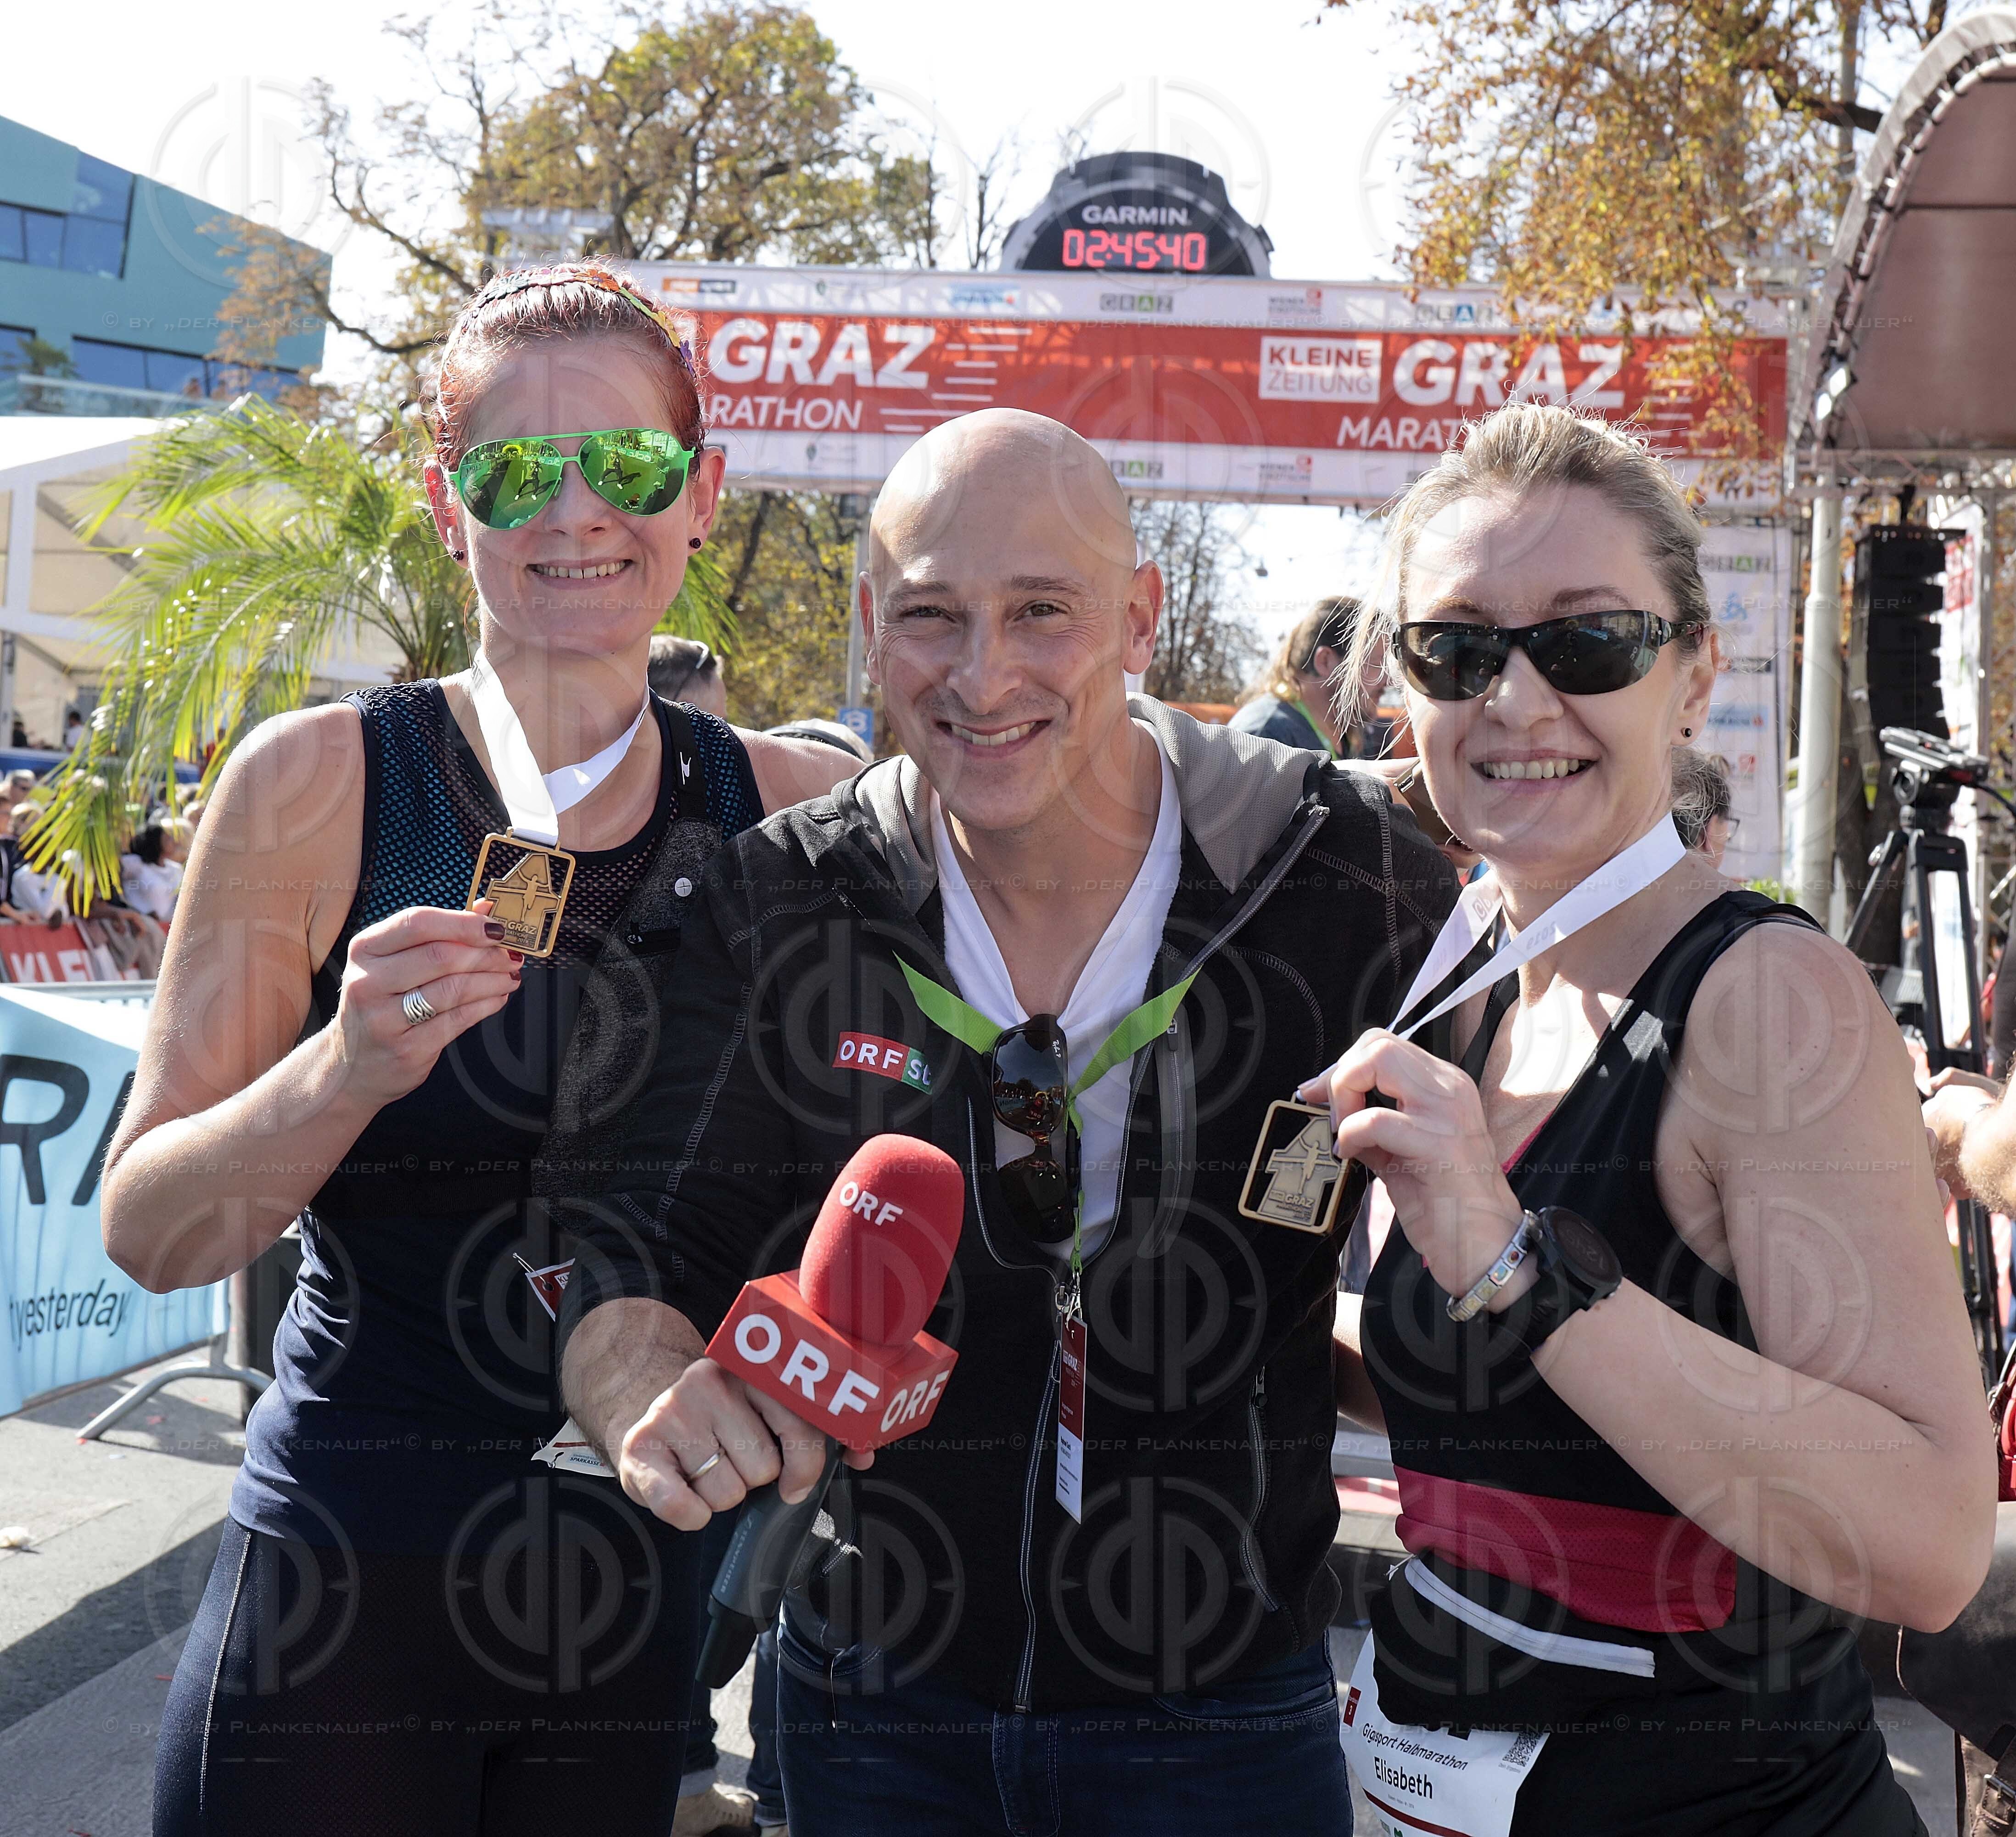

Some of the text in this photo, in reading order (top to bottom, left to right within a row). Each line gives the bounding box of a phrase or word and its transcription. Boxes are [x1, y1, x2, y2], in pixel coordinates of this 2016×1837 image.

[1082, 205, 1189, 225] GARMIN
[708, 317, 936, 389] GRAZ
[1269, 347, 1372, 368] KLEINE
[1267, 370, 1372, 394] ZEITUNG
[1393, 339, 1625, 408] GRAZ
[709, 393, 863, 430] RATHON
[1336, 415, 1462, 449] MARAT
[507, 921, 537, 935] GRAZ
[839, 1039, 903, 1069] ORF
[839, 1181, 904, 1226] ORF
[1285, 1194, 1315, 1208] GRAZ
[16, 1278, 132, 1353] yesterday
[734, 1313, 880, 1416] ORF
[880, 1370, 950, 1433] ORF
[1395, 1738, 1468, 1770] Halbmarathon
[1374, 1756, 1433, 1800] Elisabeth
